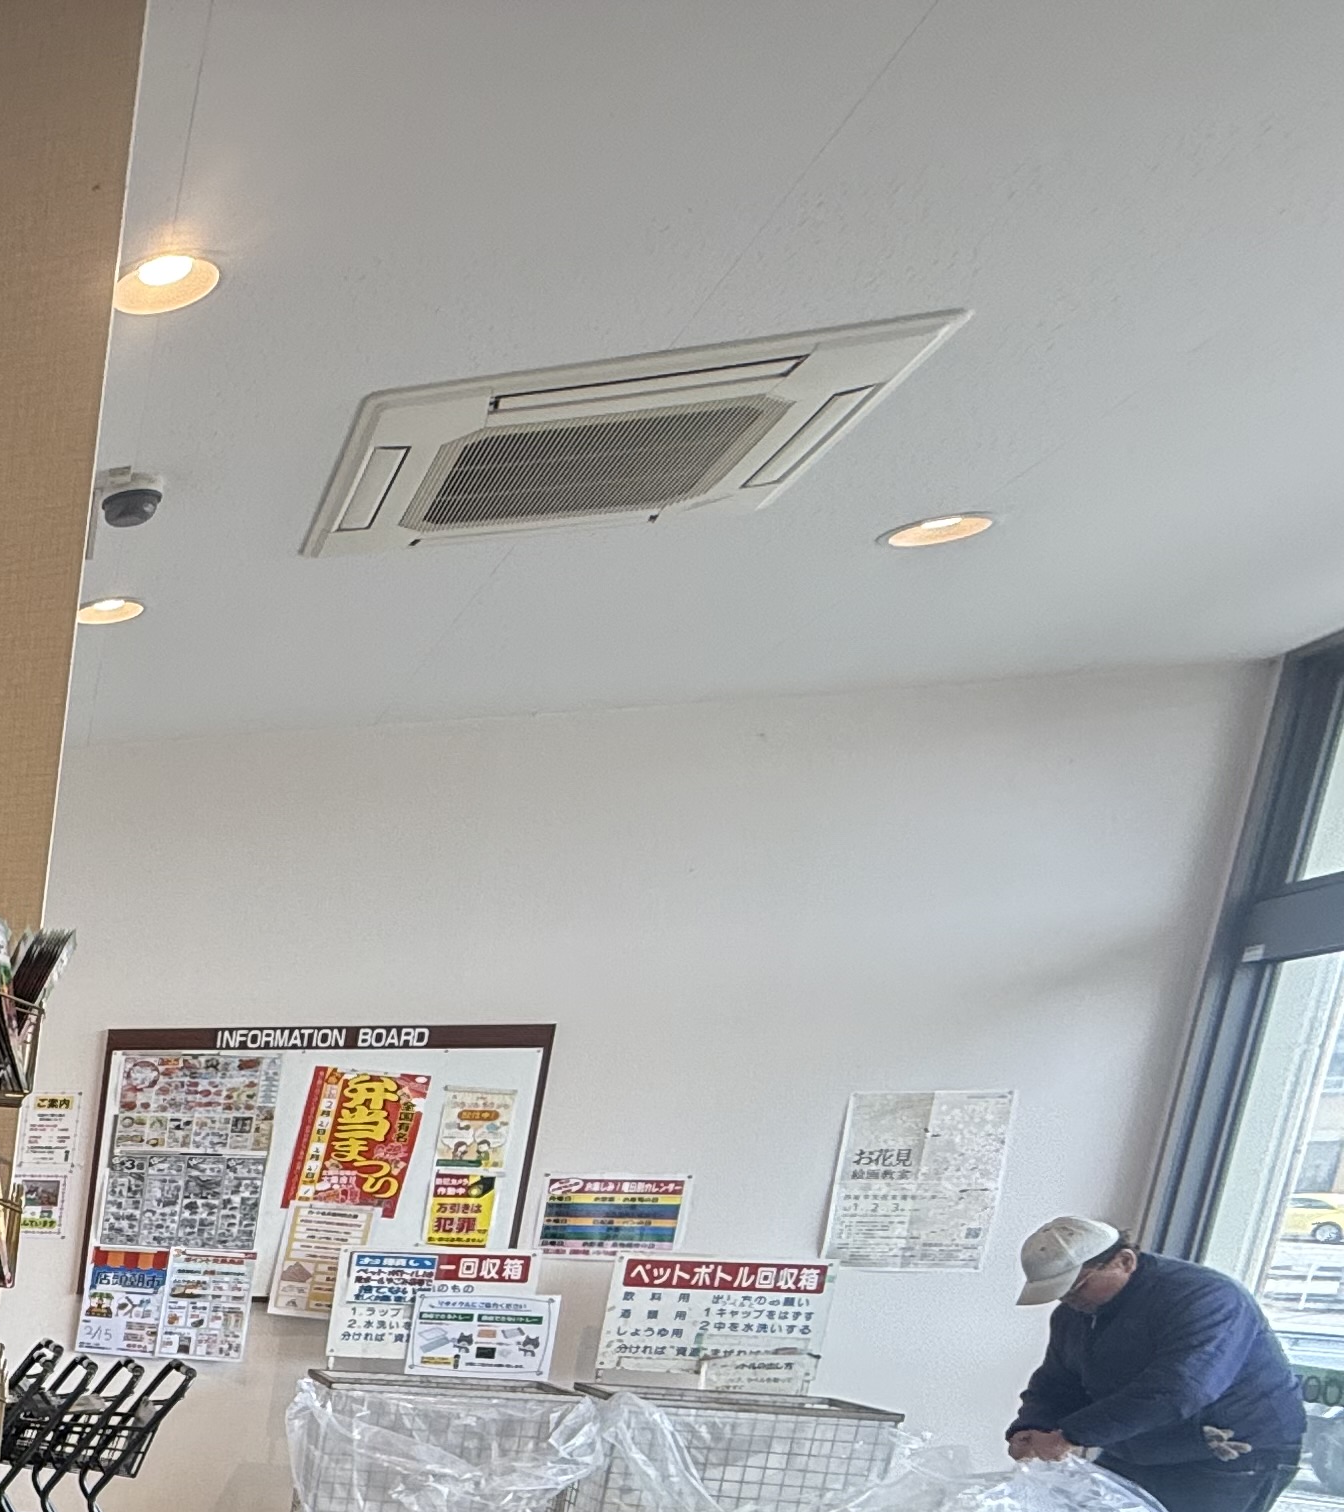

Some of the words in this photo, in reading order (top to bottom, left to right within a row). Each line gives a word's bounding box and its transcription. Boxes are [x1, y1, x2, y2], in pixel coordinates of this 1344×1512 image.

[216, 1029, 346, 1048] INFORMATION
[357, 1028, 430, 1047] BOARD
[36, 1097, 71, 1109] ご案内
[395, 1101, 417, 1144] 全国有名
[330, 1073, 400, 1199] 弁当まつり
[852, 1149, 913, 1167] お花見
[850, 1169, 912, 1181] 絵画教室
[436, 1187, 466, 1197] 作動中
[436, 1202, 482, 1215] 万引きは
[433, 1217, 476, 1234] 犯罪
[358, 1257, 432, 1267] お願い
[629, 1265, 823, 1292] ペットボトル回収箱
[715, 1309, 816, 1322] キャップをはずす
[83, 1325, 113, 1342] 2/15
[615, 1326, 684, 1340] しょうゆ用
[698, 1321, 709, 1332] 2
[713, 1321, 813, 1336] 中を水洗いする
